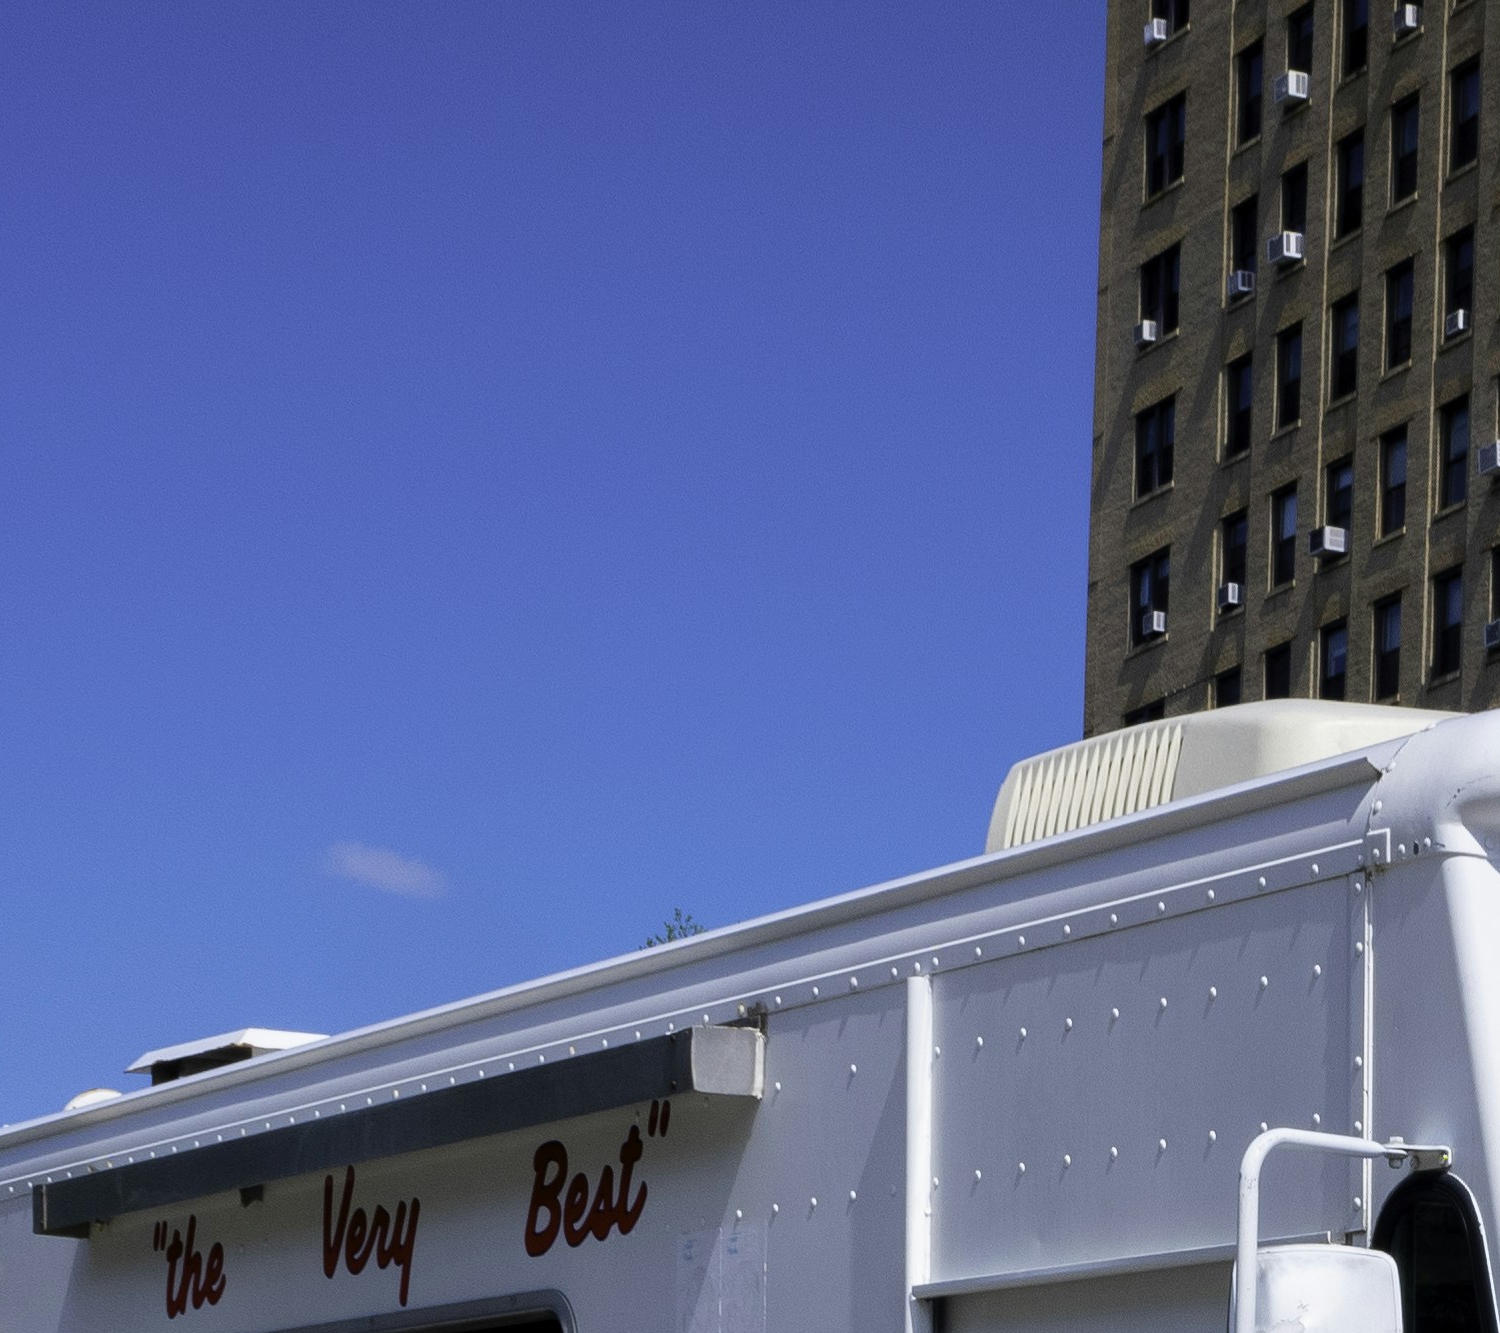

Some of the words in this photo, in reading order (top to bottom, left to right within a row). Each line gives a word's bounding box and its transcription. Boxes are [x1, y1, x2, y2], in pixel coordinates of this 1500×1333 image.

[154, 1215, 227, 1319] "the
[321, 1166, 420, 1306] Very
[524, 1099, 671, 1258] Best"
